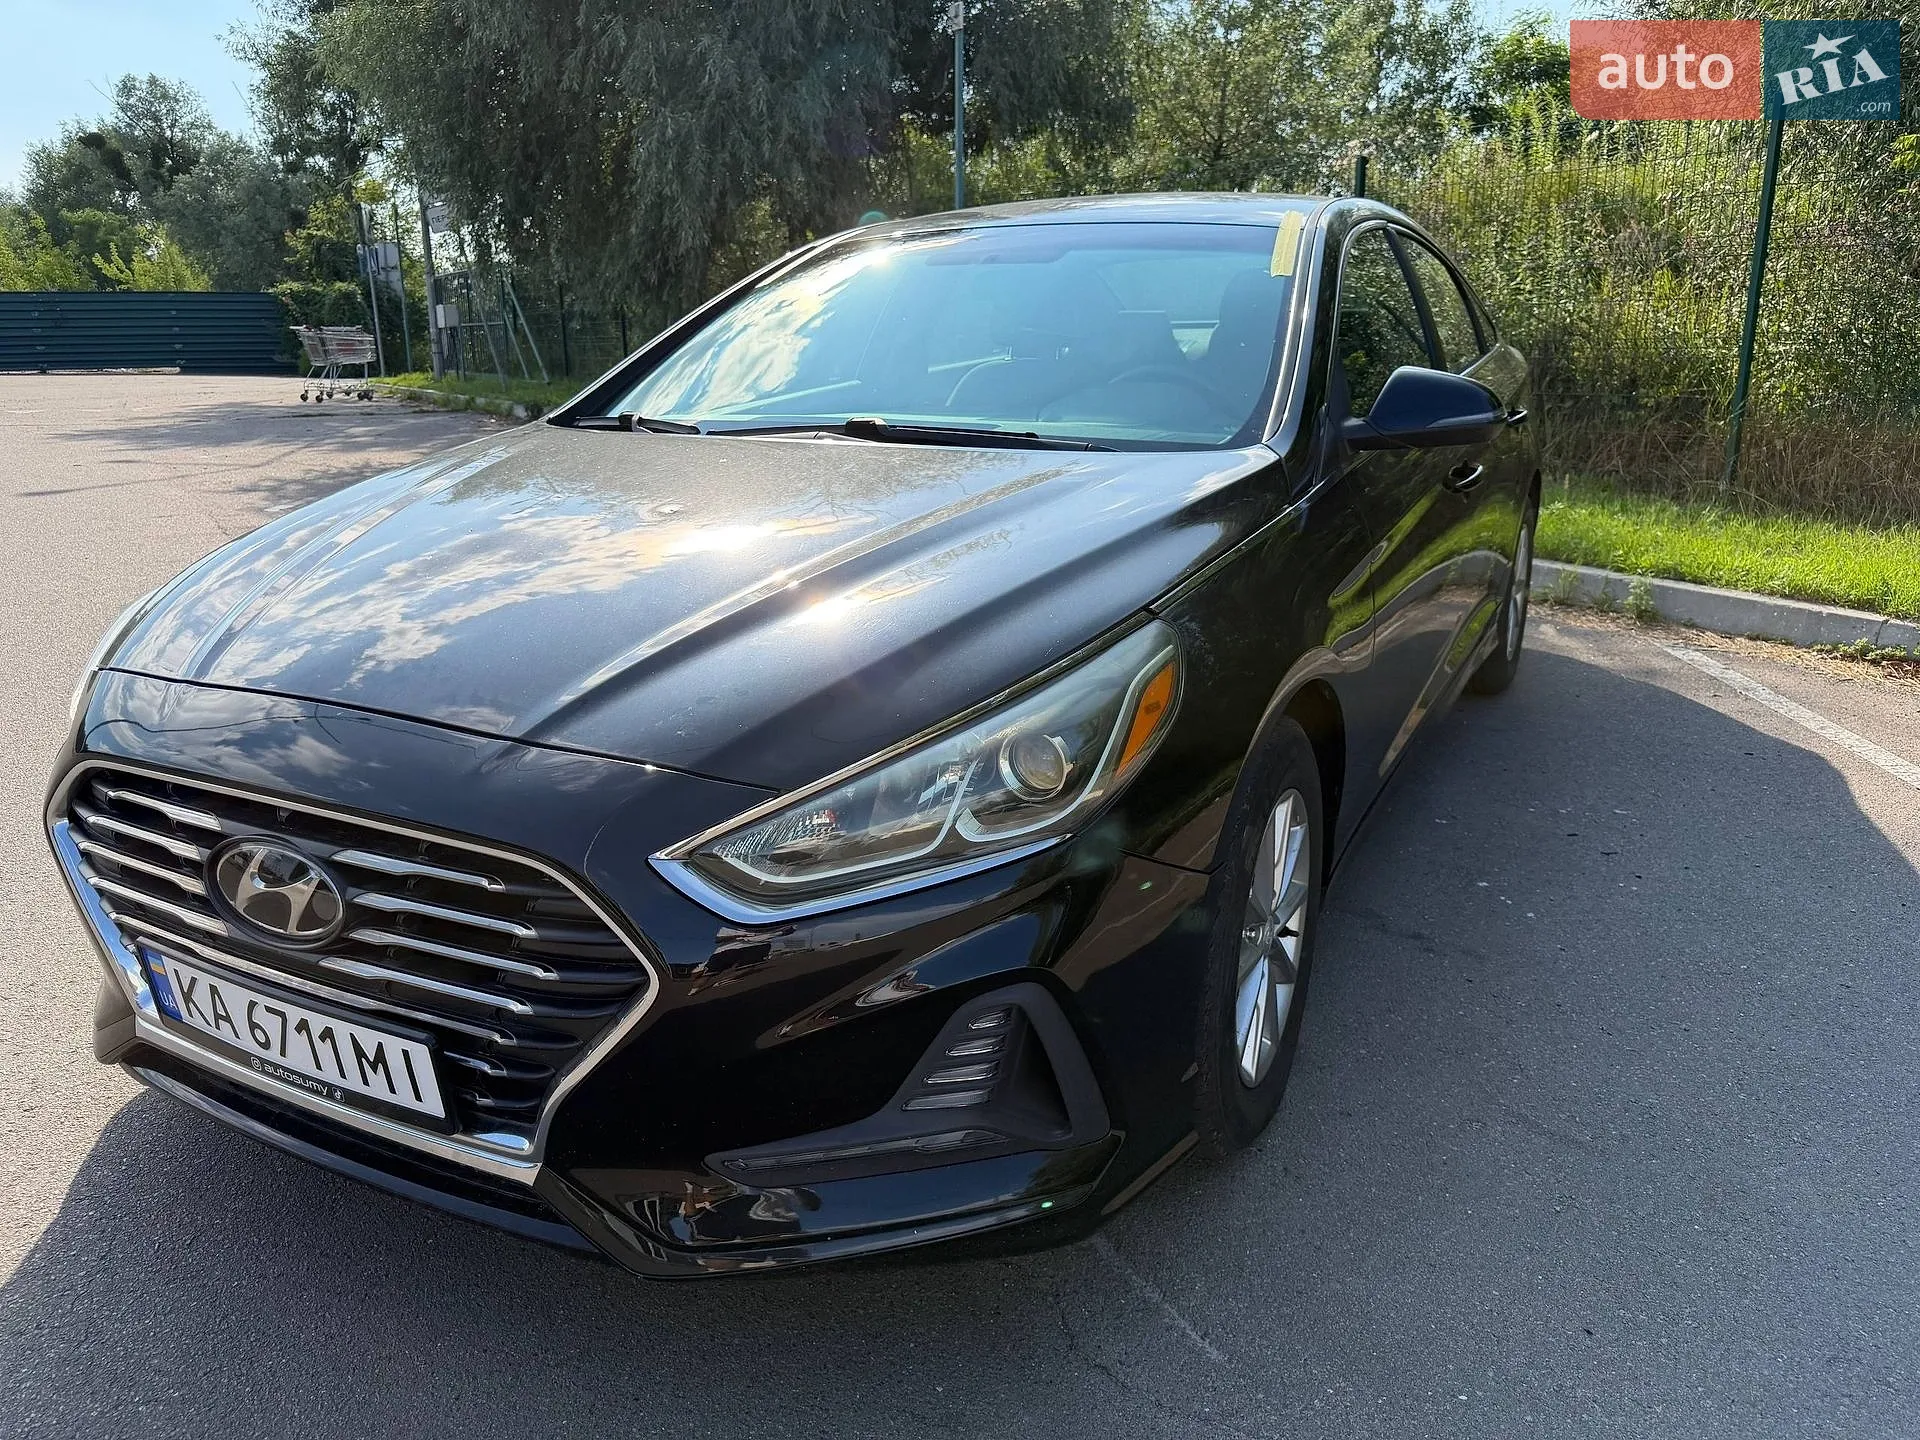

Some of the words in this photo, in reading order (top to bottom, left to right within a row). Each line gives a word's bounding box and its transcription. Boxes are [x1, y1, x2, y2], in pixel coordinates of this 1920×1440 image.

[159, 990, 178, 1010] UA
[173, 967, 240, 1040] KA
[246, 999, 348, 1080] 6711
[350, 1032, 424, 1104] MI
[264, 1063, 328, 1096] autosumy
